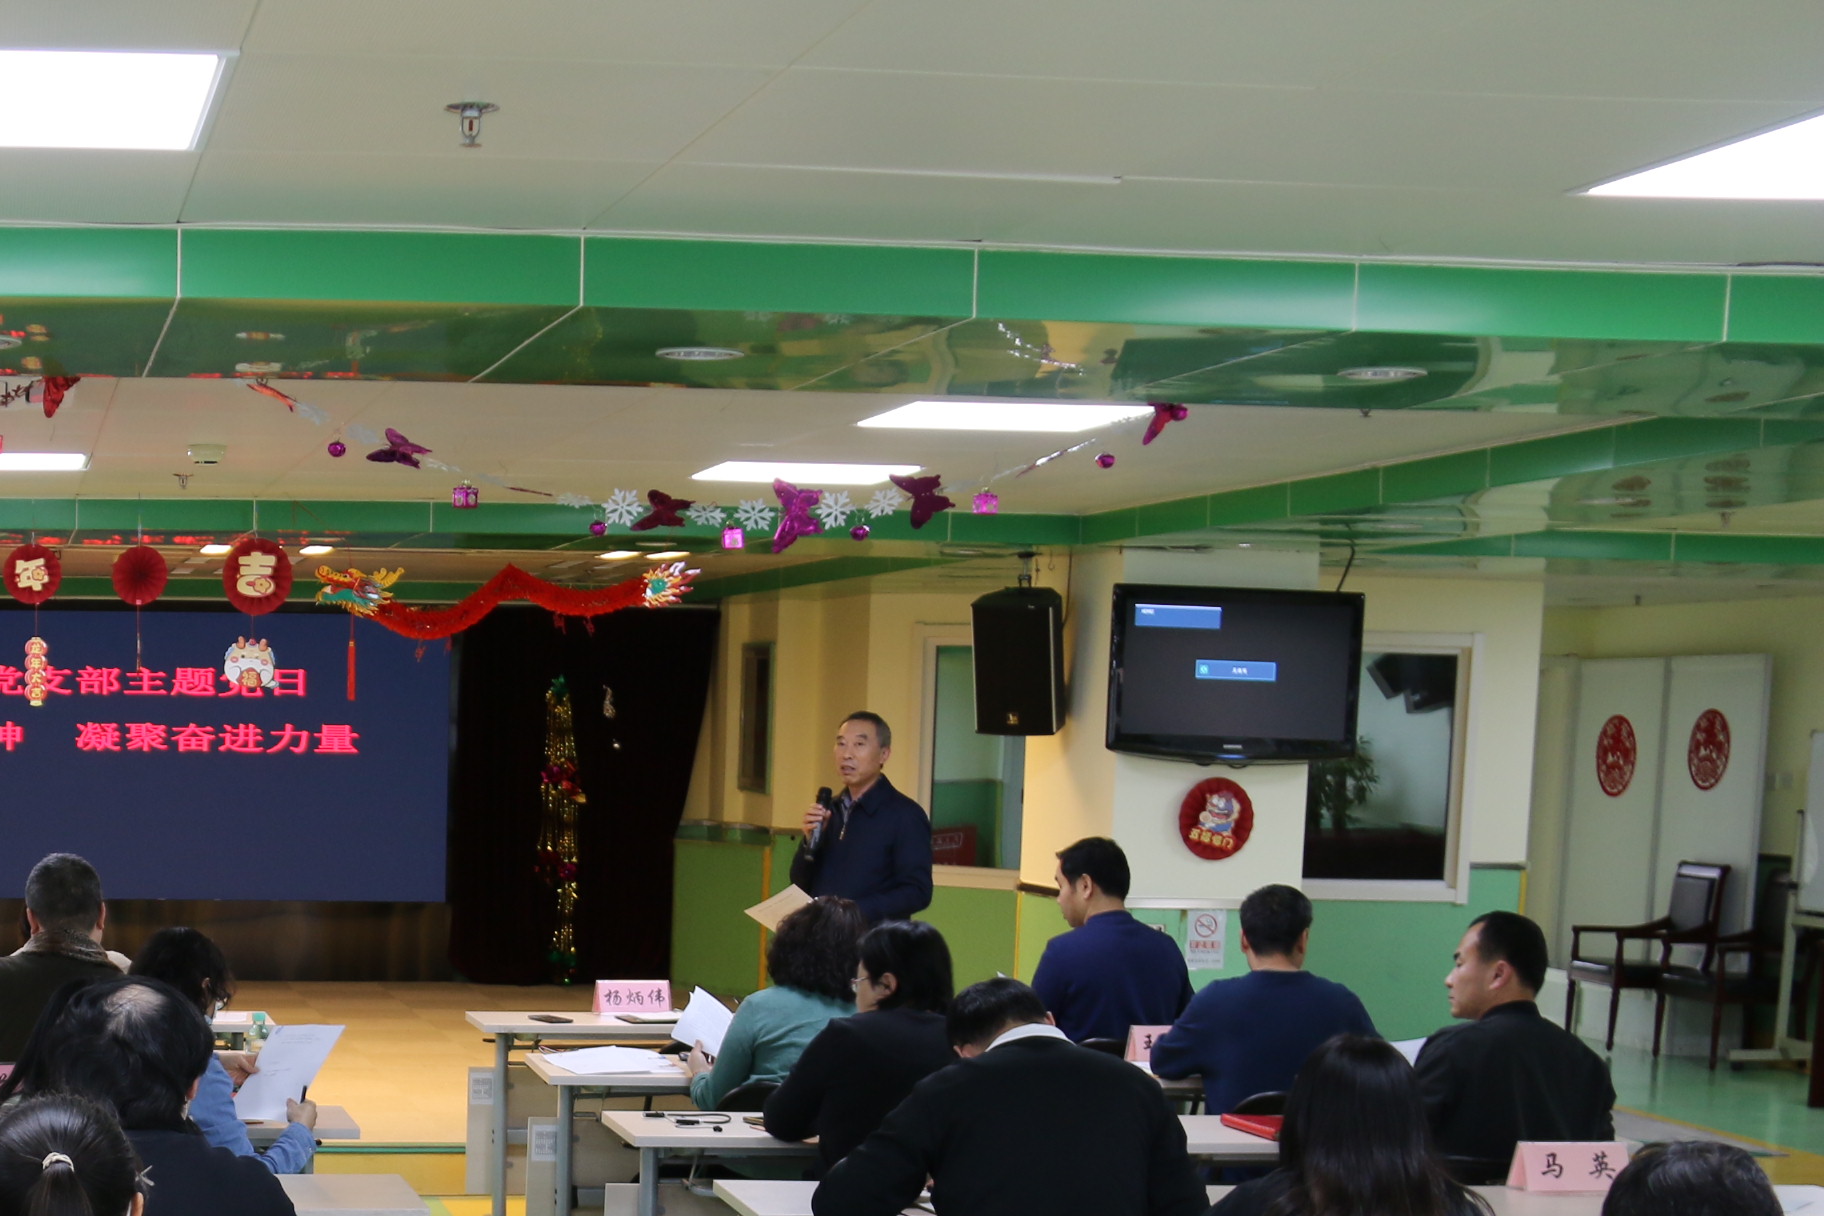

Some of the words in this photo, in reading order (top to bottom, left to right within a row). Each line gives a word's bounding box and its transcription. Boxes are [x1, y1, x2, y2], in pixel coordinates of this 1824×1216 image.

[14, 557, 51, 592] 年
[236, 551, 277, 598] 吉
[241, 671, 258, 688] 福
[75, 722, 360, 754] 凝聚奋进力量
[1541, 1150, 1616, 1179] 马英
